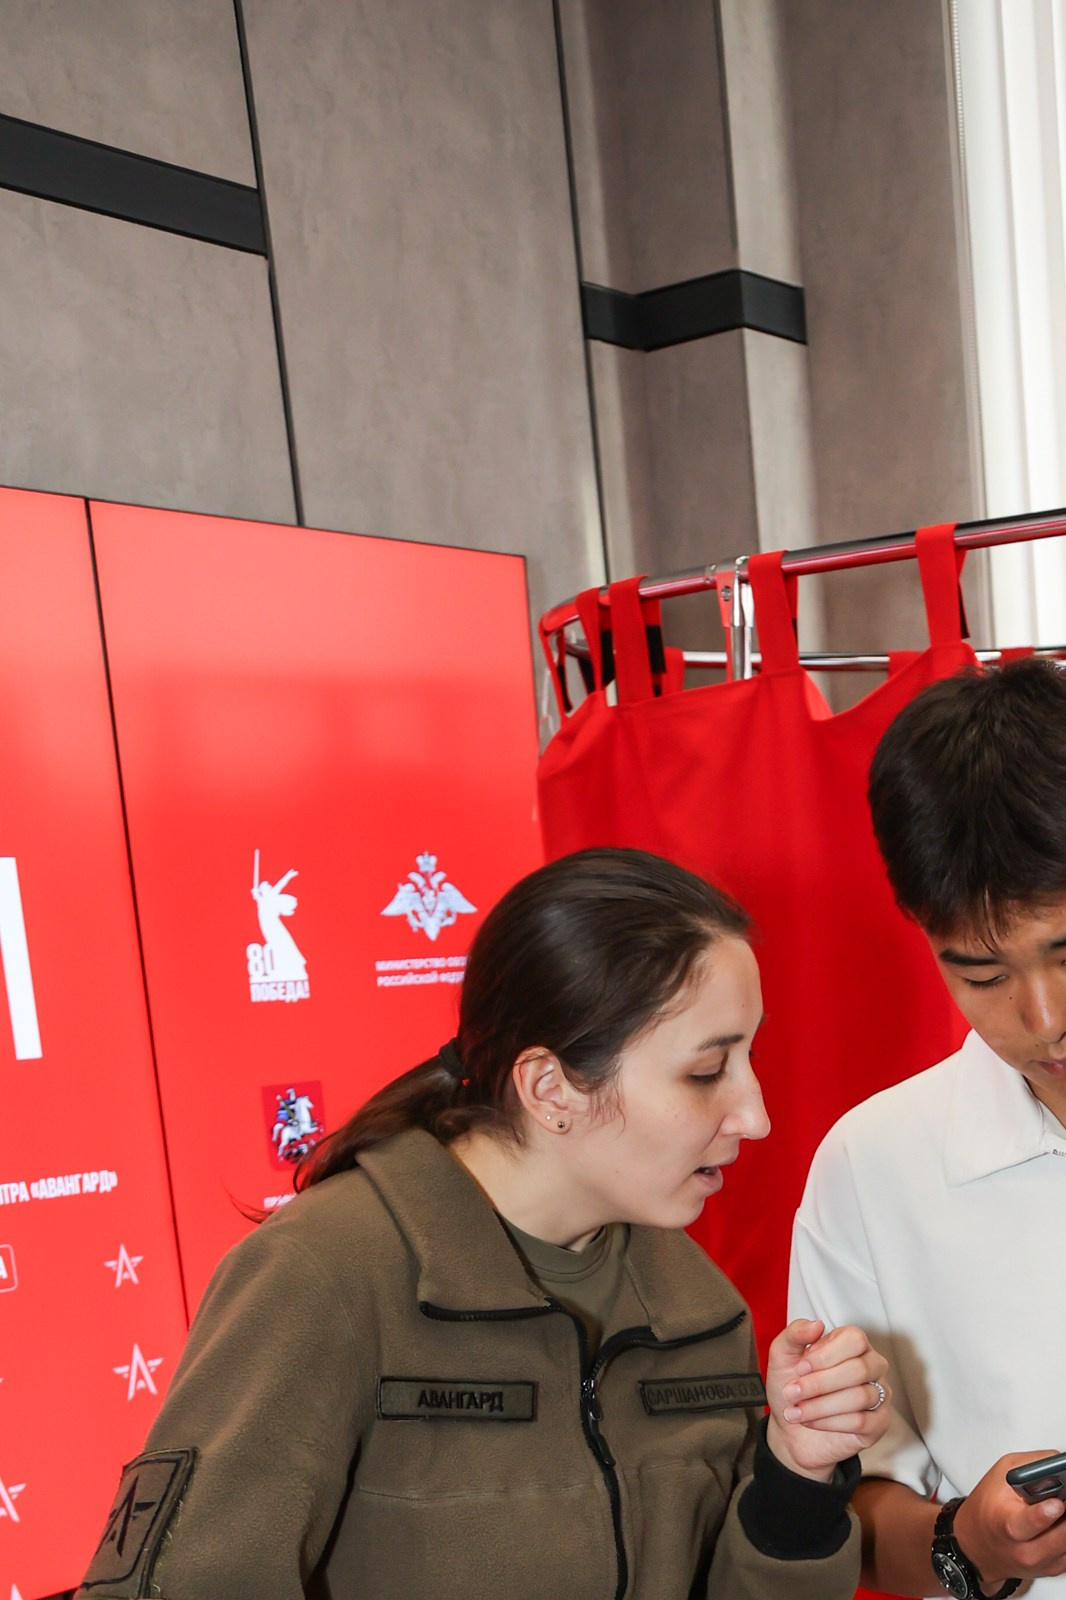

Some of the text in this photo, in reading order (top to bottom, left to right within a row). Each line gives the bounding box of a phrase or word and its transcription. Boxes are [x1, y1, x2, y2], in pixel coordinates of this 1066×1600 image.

[250, 980, 310, 1003] ПОБЕДА!
[30, 1169, 118, 1200] «АВАНГАРД»
[418, 1389, 504, 1412] АВАНГАРД
